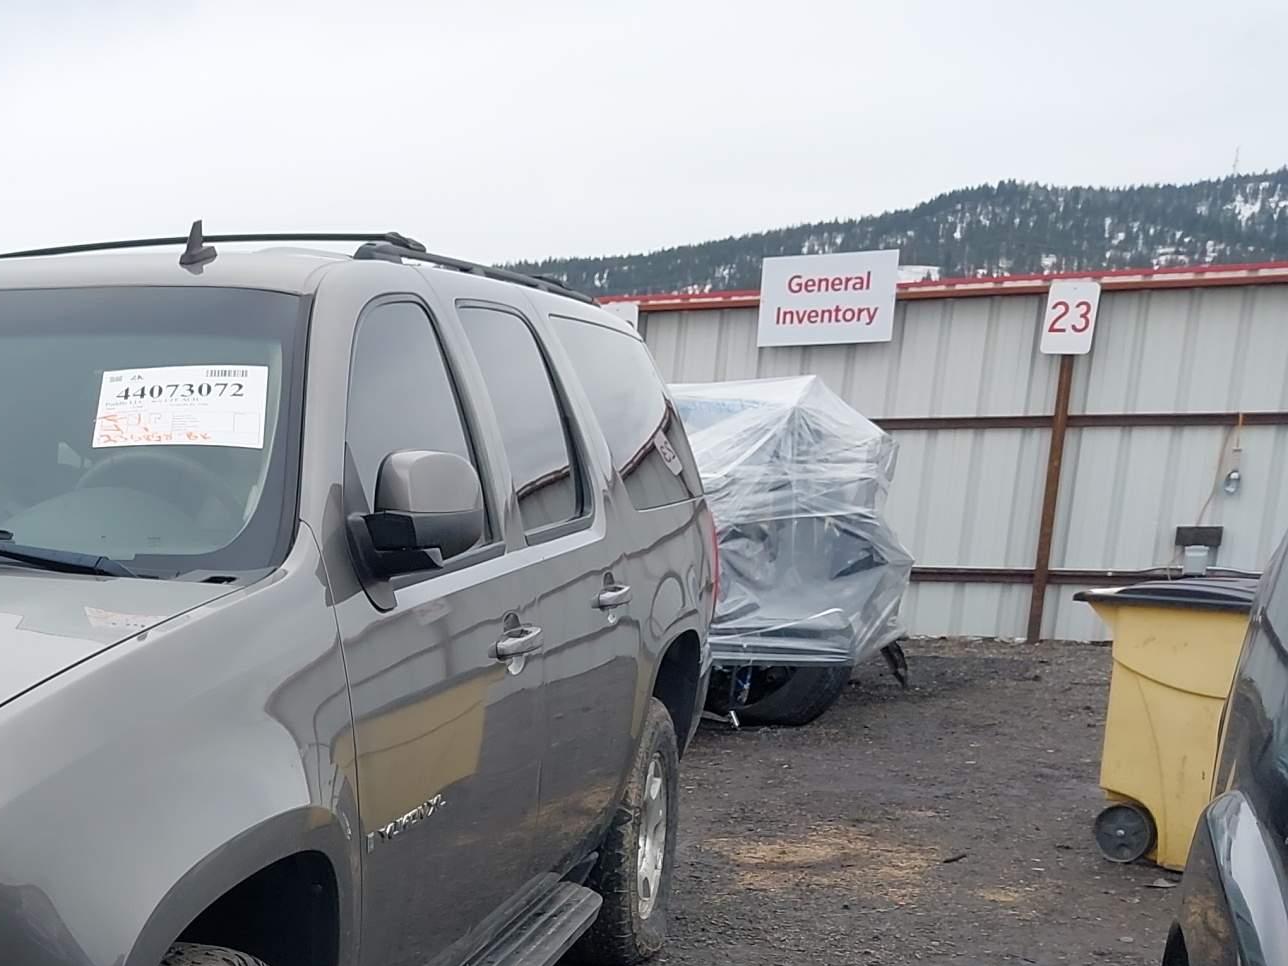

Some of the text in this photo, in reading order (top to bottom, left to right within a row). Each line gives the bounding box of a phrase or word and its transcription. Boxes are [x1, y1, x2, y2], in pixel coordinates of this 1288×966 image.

[787, 271, 871, 294] General
[775, 305, 879, 326] Inventory
[1047, 300, 1092, 334] 23
[116, 383, 245, 401] 44073072
